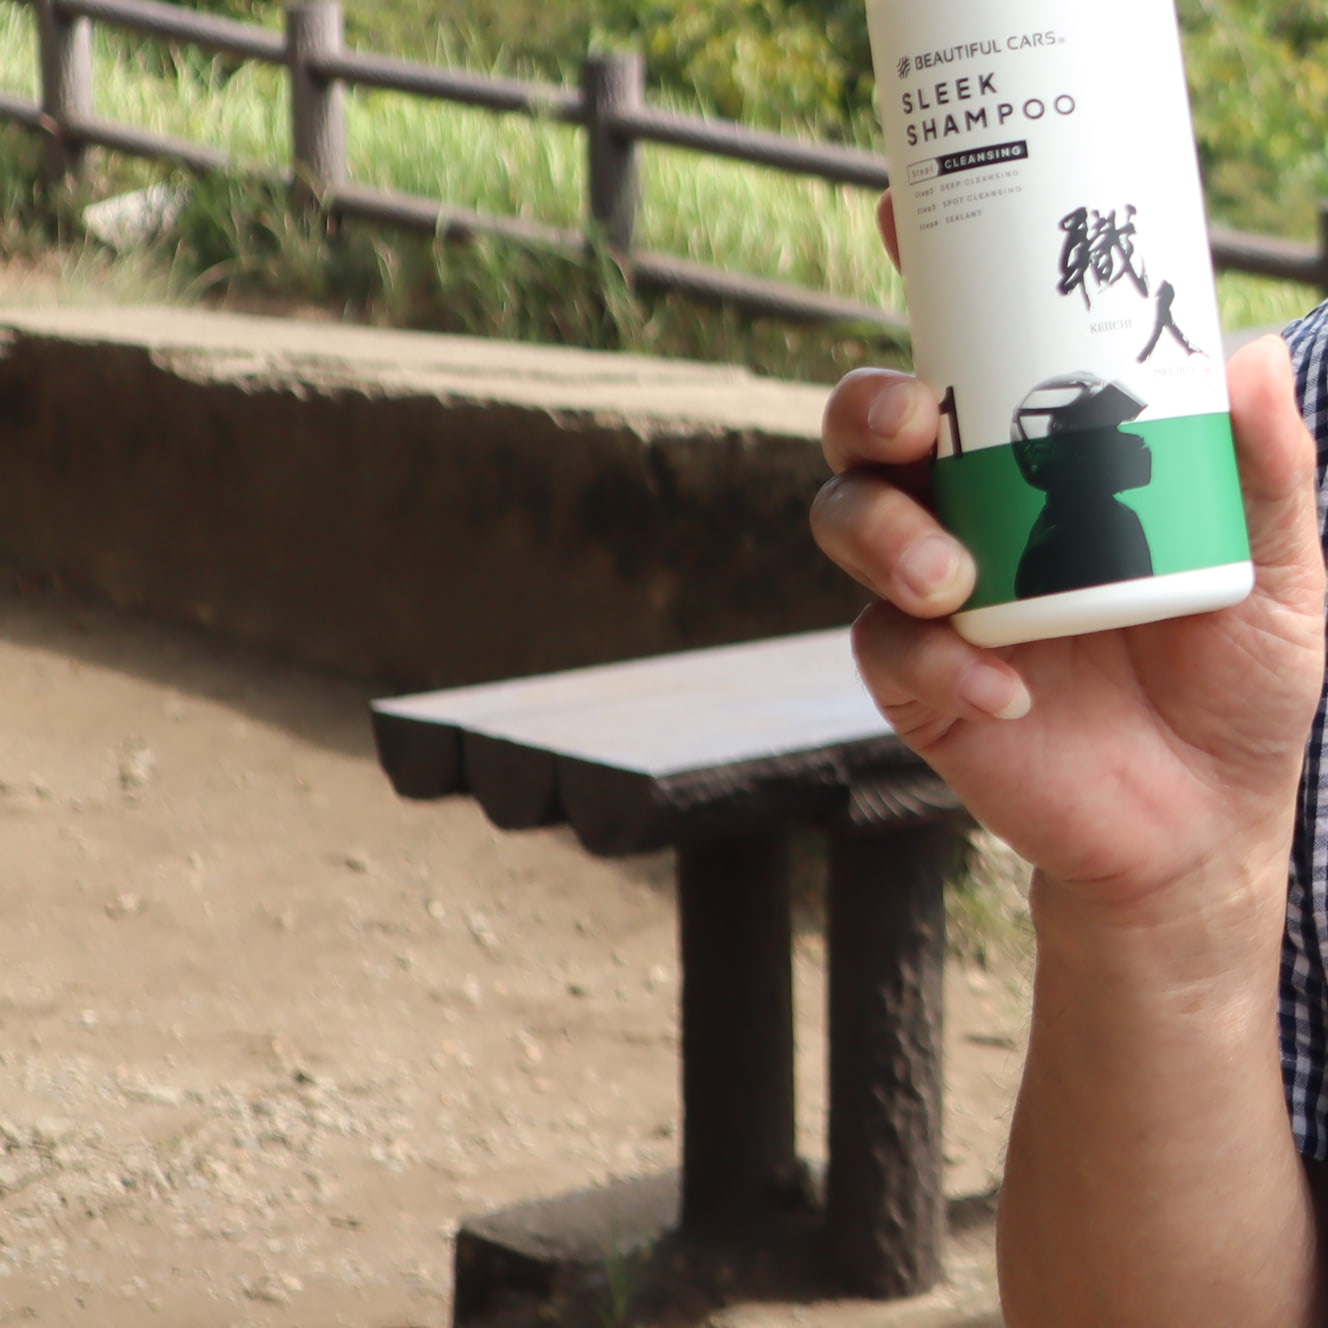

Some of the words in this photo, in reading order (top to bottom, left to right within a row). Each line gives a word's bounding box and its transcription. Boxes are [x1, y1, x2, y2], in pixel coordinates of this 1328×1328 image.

[914, 39, 1001, 71] BEAUTIFUL
[902, 73, 997, 114] SLEEK
[907, 94, 1076, 146] SHAMPOO
[943, 144, 1022, 169] CLEANSING
